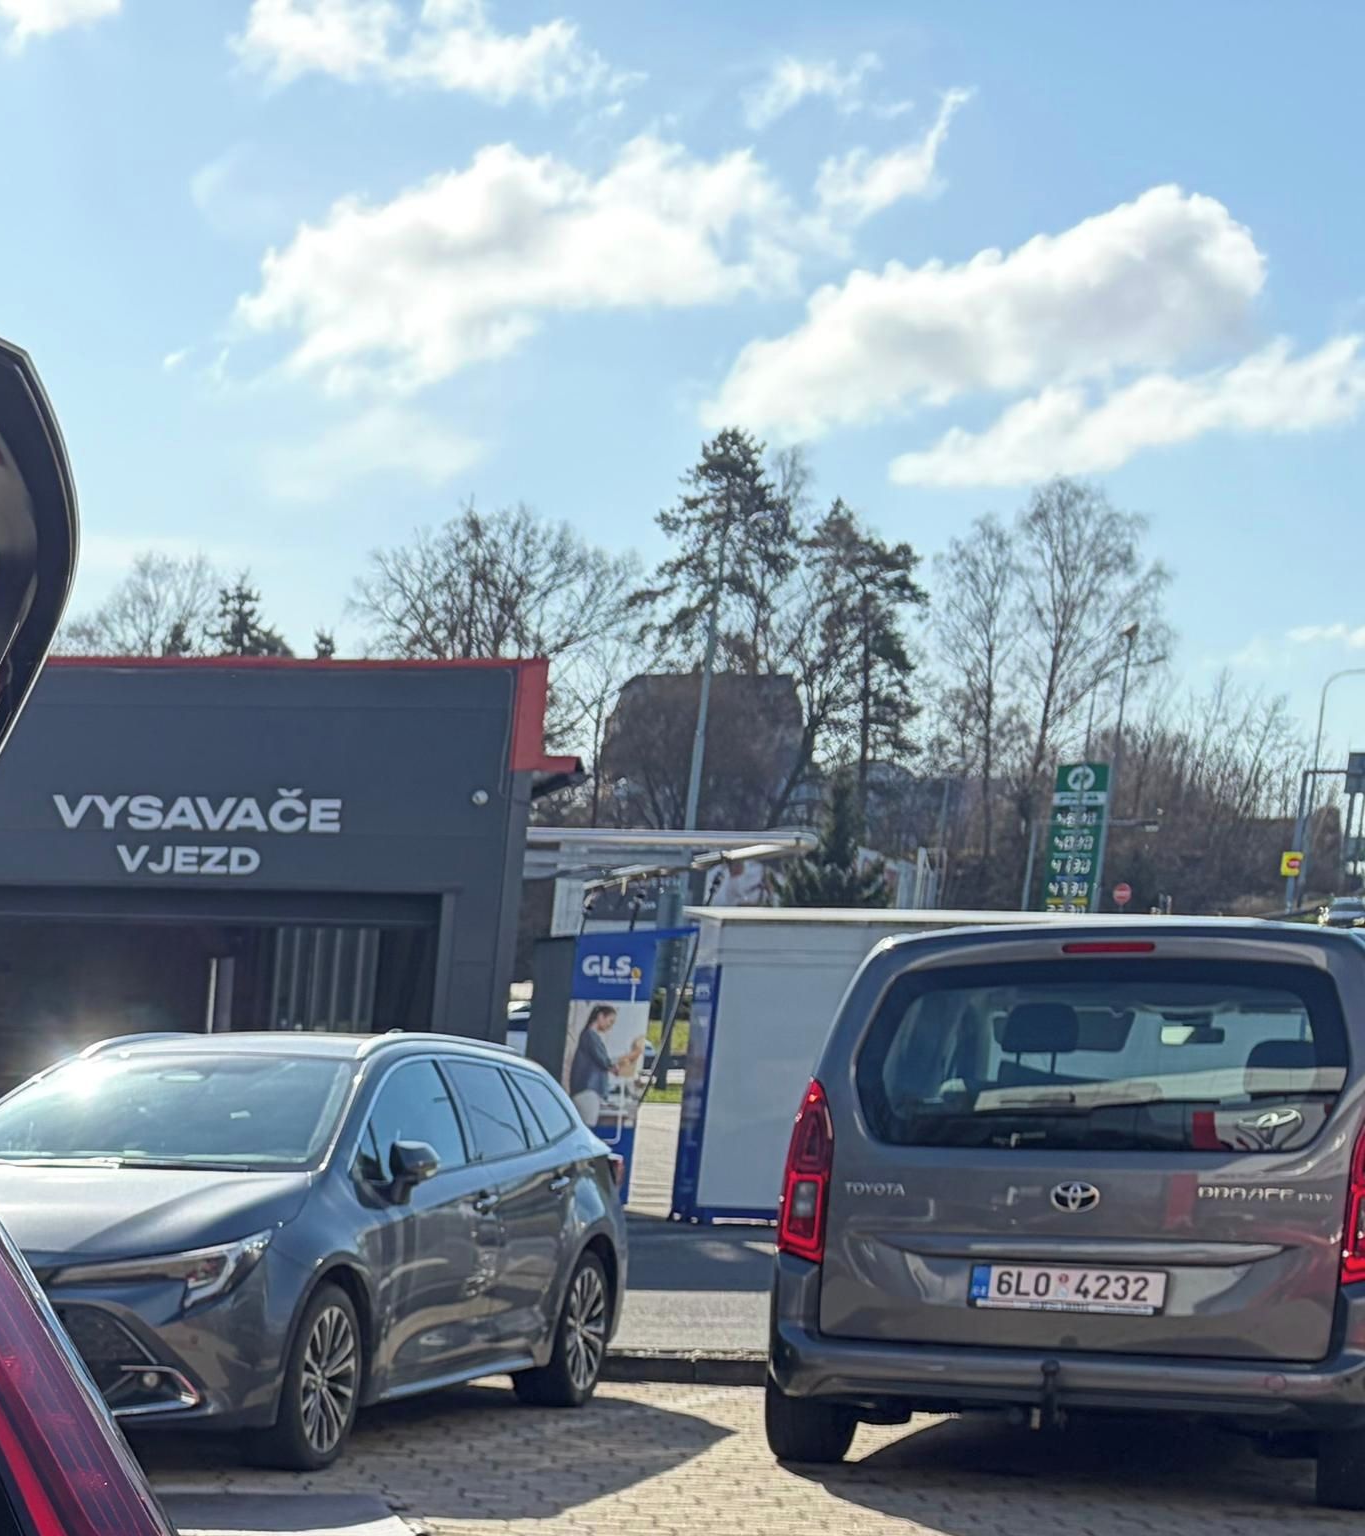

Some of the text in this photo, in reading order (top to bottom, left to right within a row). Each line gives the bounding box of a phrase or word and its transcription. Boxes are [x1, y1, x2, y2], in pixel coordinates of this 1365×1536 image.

[52, 787, 342, 834] VYSAVAČE
[844, 1181, 906, 1197] TOYOTA
[1074, 1273, 1150, 1302] 4232
